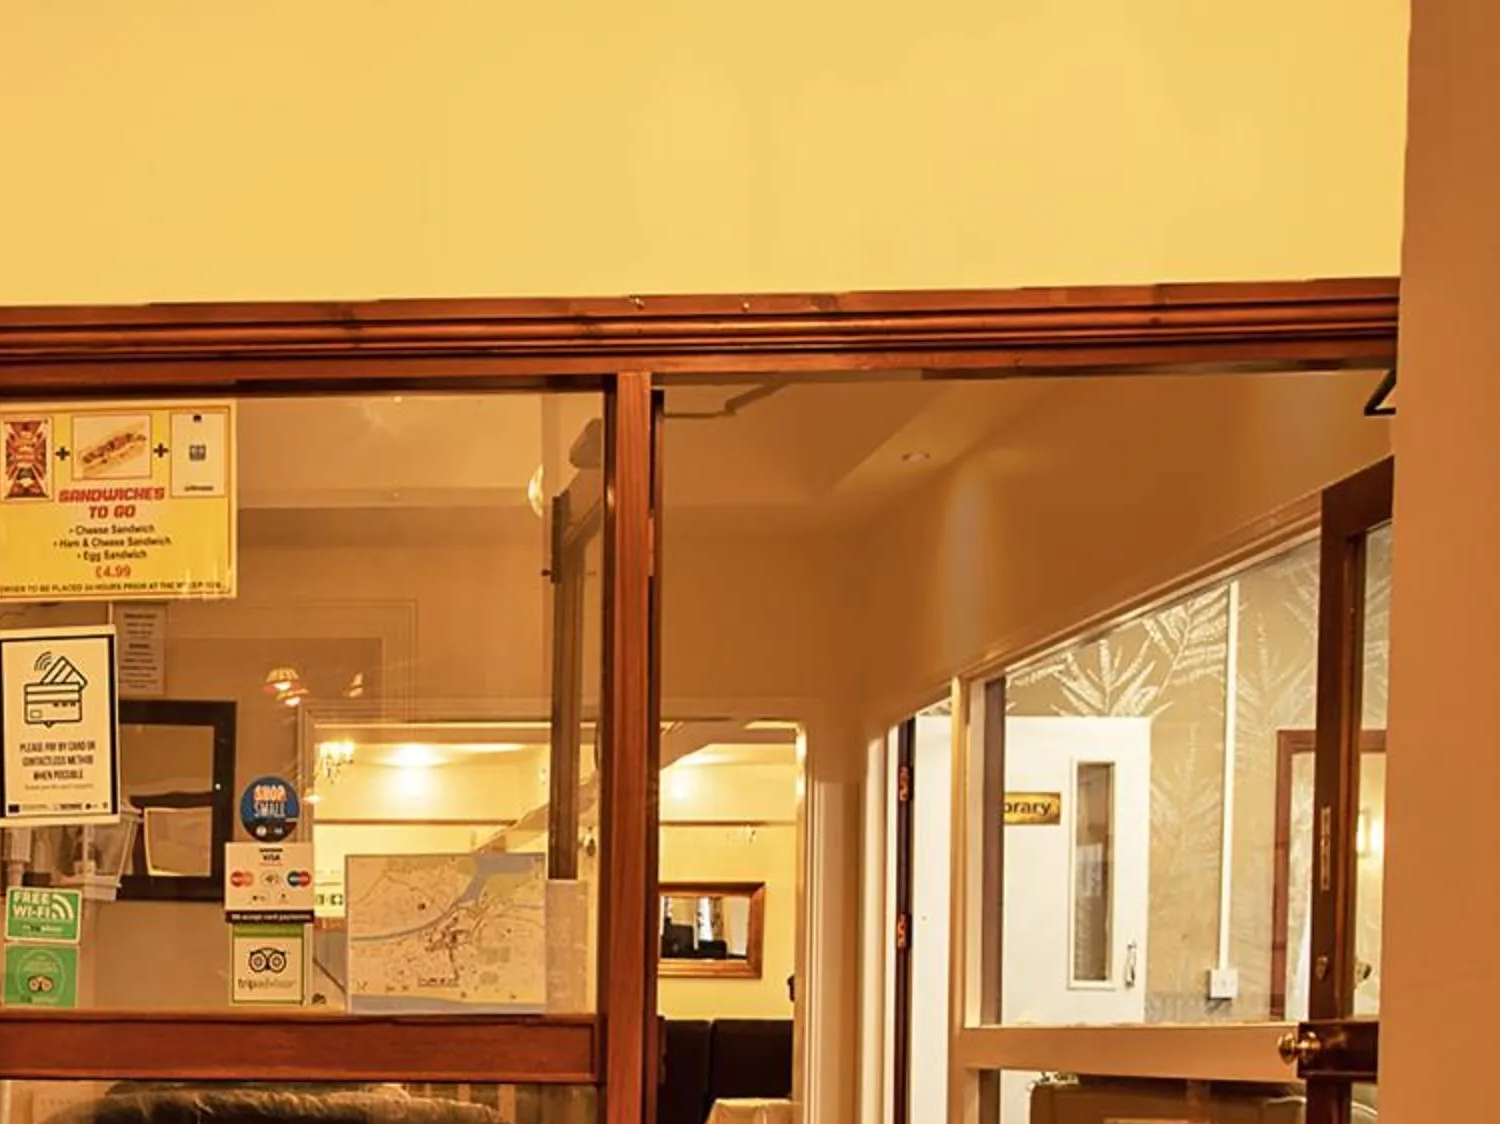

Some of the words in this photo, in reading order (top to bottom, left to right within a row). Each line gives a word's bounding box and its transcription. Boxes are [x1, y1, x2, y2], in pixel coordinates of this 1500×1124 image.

[58, 487, 166, 503] SANDWICHES
[89, 505, 109, 519] TO
[113, 504, 137, 518] GO
[76, 525, 109, 535] Cheese
[111, 524, 155, 534] Sandwich
[60, 538, 79, 548] Ham
[92, 538, 125, 548] Cheese
[127, 536, 172, 547] Sandwich
[83, 551, 101, 562] Egg
[103, 550, 147, 560] Sandwich
[20, 742, 43, 753] PLEASE
[45, 742, 56, 751] PAY
[68, 741, 85, 751] CARD
[33, 770, 52, 781] WHEN
[54, 768, 83, 780] POSSIBLE
[254, 784, 287, 801] SHOP
[254, 801, 286, 817] SMALL
[13, 891, 49, 905] FREE
[13, 905, 50, 918] WI-FI
